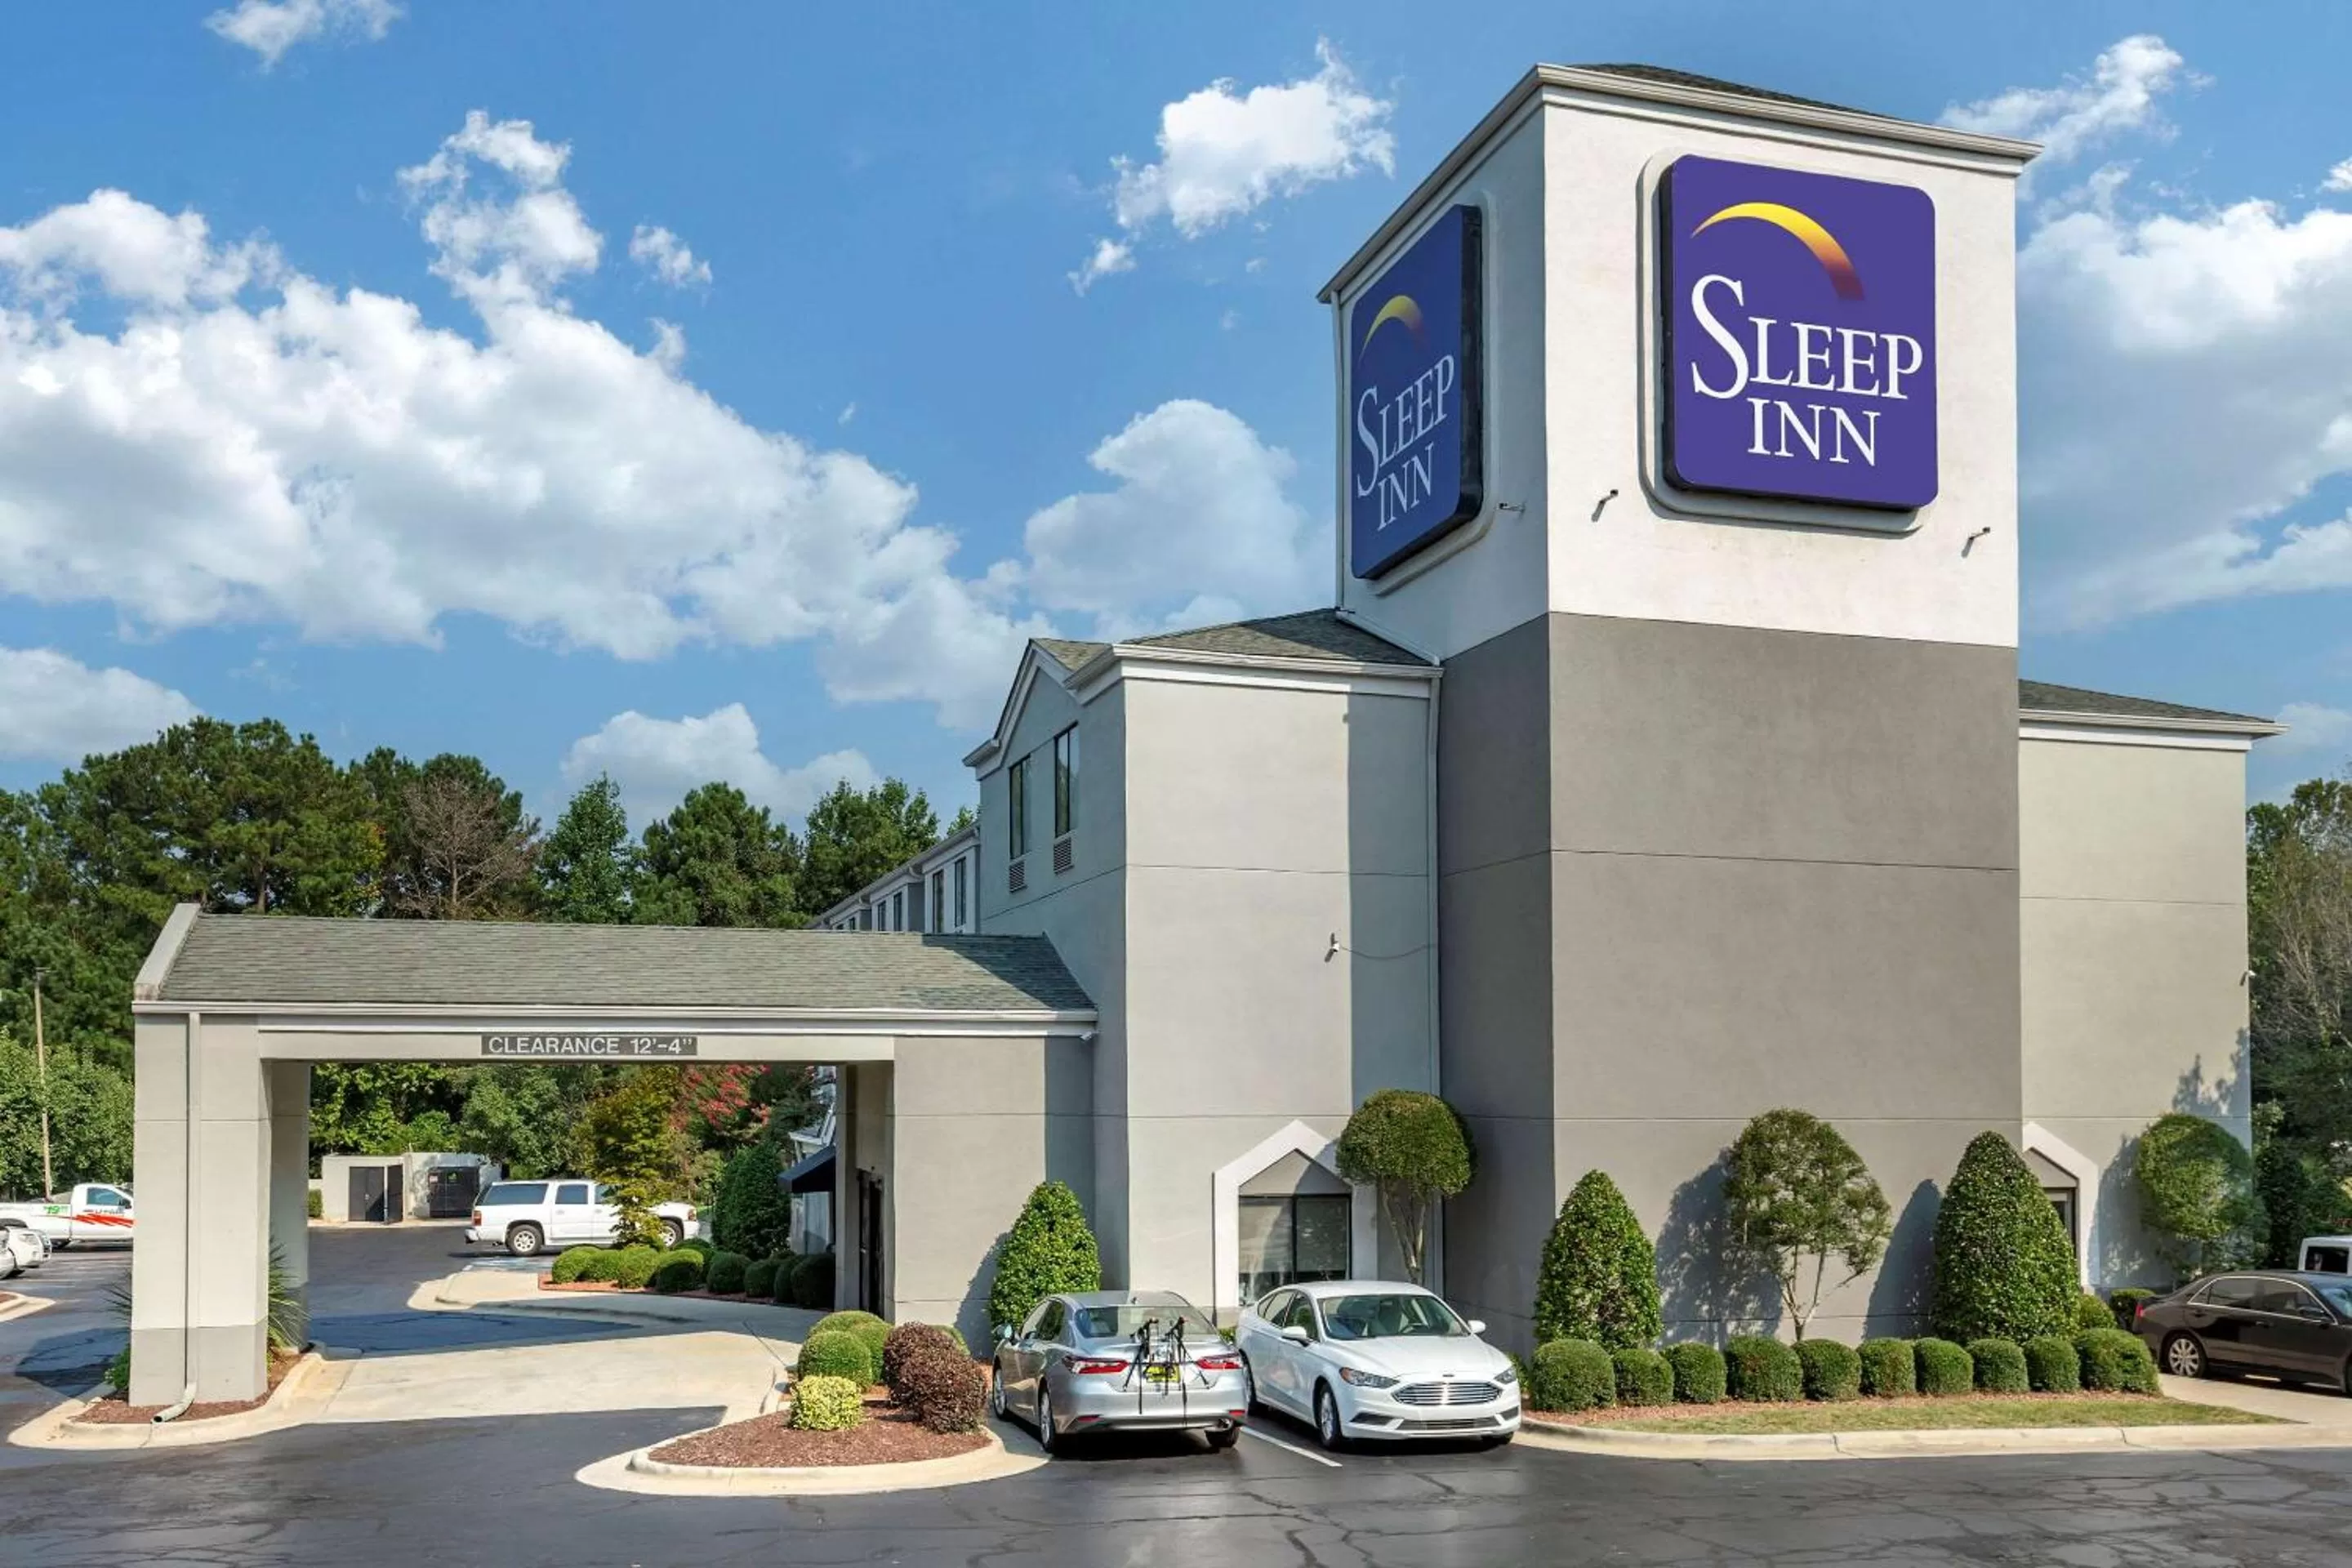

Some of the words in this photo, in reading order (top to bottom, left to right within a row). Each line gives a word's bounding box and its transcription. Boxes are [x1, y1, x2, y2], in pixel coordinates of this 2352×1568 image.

[1747, 397, 1881, 466] INN
[1377, 442, 1434, 531] INN
[489, 1036, 621, 1054] CLEARANCE
